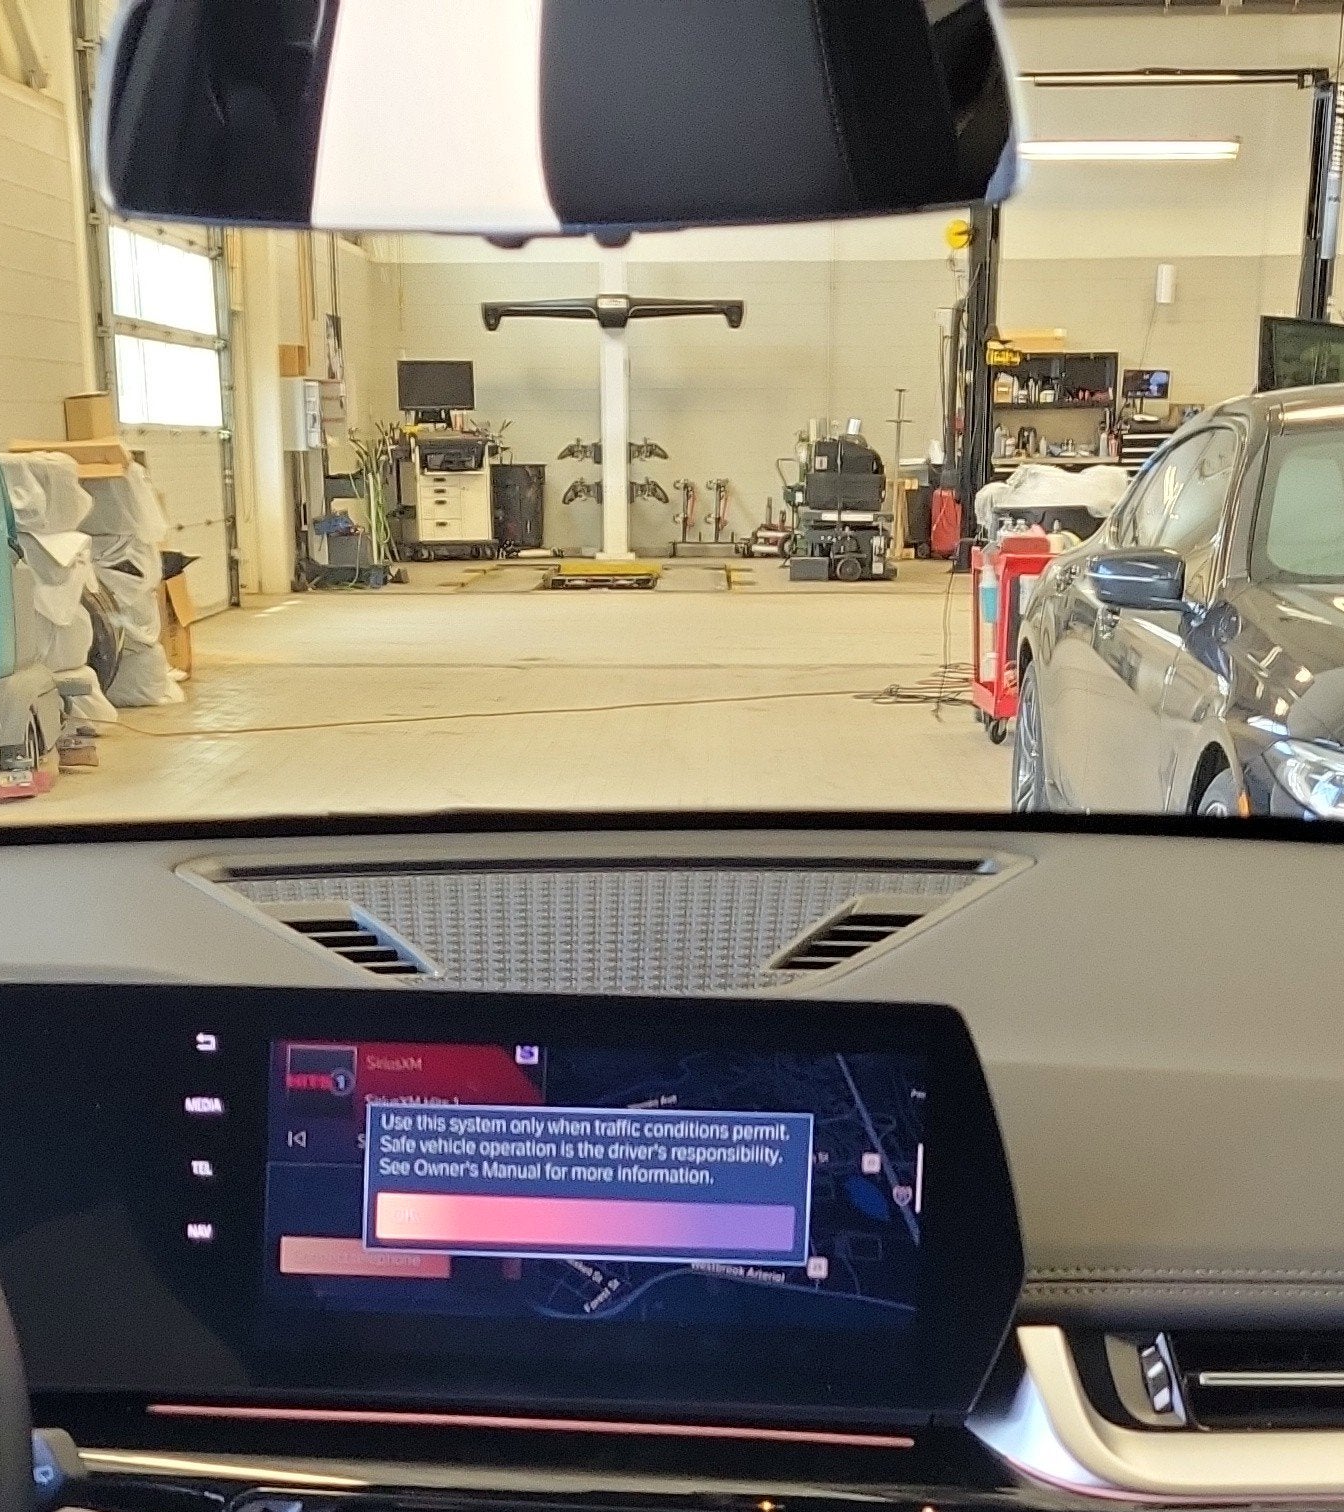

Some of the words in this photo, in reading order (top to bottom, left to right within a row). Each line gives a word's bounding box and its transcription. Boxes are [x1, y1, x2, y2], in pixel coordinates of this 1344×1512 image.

[366, 1055, 423, 1072] SiriusXM
[184, 1097, 224, 1113] MEDIA
[381, 1113, 413, 1131] Use
[417, 1114, 446, 1132] this
[449, 1116, 506, 1135] system
[510, 1117, 544, 1138] only
[547, 1118, 591, 1136] when
[595, 1119, 641, 1138] traffic
[644, 1121, 729, 1140] conditions
[732, 1123, 790, 1143] permit.
[380, 1135, 416, 1153] Safe
[420, 1137, 476, 1155] vehicle
[479, 1139, 556, 1159] operation
[562, 1141, 574, 1158] is
[578, 1141, 605, 1159] the
[609, 1142, 667, 1161] driver's
[671, 1145, 783, 1167] responsibility.
[191, 1160, 214, 1176] TEL
[379, 1157, 410, 1176] See
[414, 1159, 479, 1178] Owner's
[482, 1161, 541, 1180] Manual
[544, 1162, 567, 1180] for
[571, 1165, 613, 1182] more
[617, 1165, 714, 1185] information.
[186, 1223, 213, 1240] NAV
